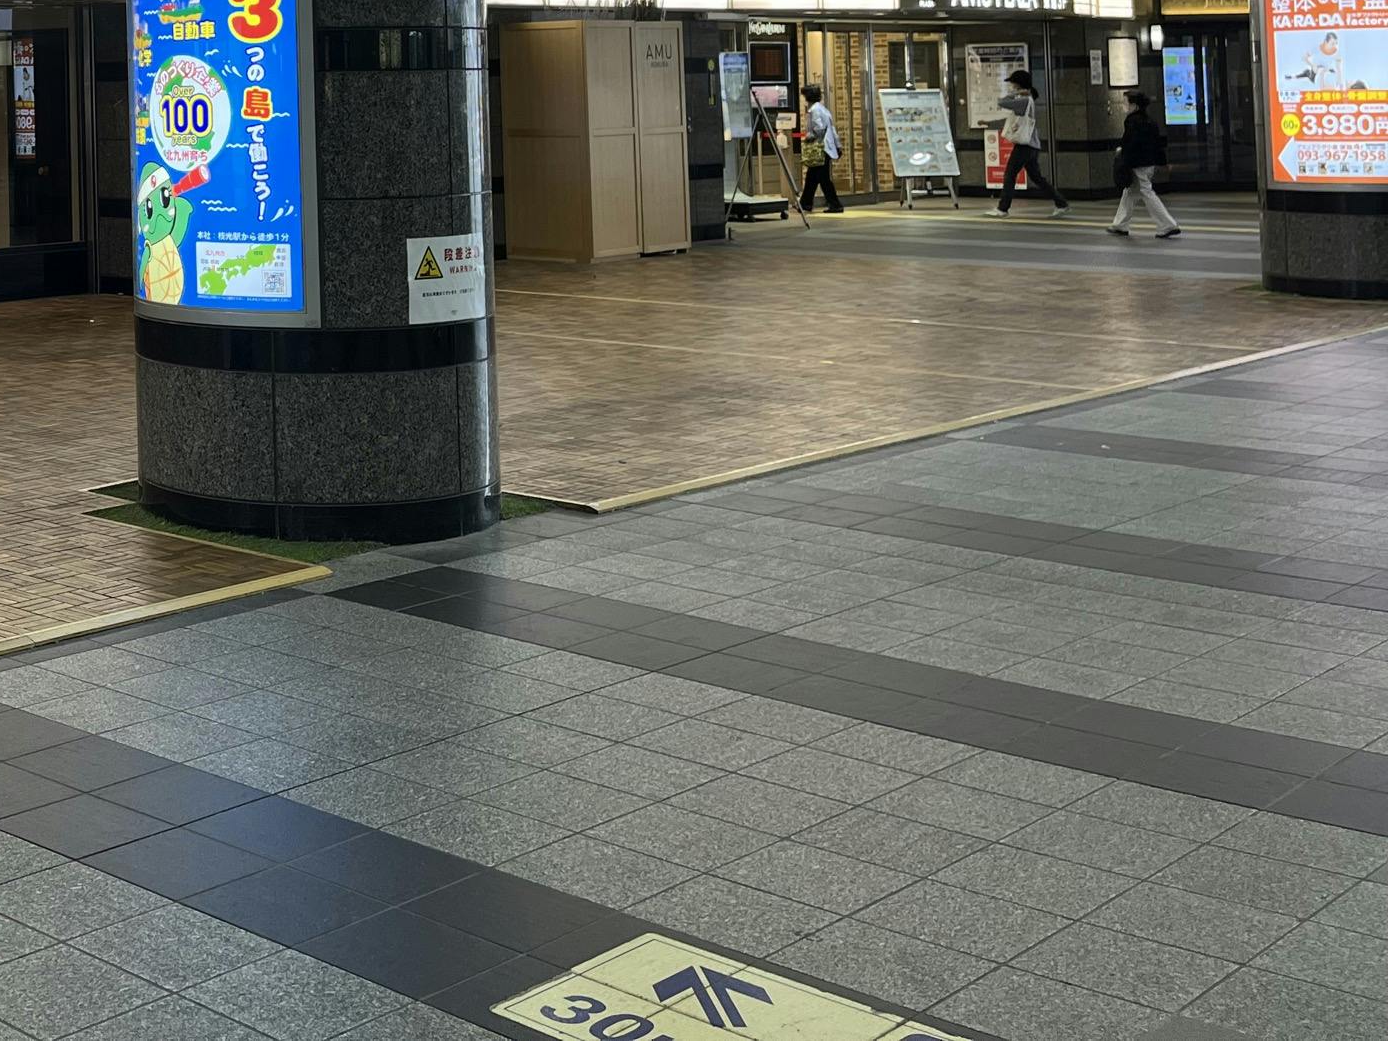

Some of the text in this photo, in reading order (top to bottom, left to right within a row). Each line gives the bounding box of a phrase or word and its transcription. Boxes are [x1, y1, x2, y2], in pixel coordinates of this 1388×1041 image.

[172, 20, 217, 41] 自動車
[645, 43, 673, 60] AMU
[173, 85, 195, 97] Over
[160, 94, 213, 139] 100
[172, 134, 199, 146] years
[1297, 150, 1386, 162] 093-967-1958
